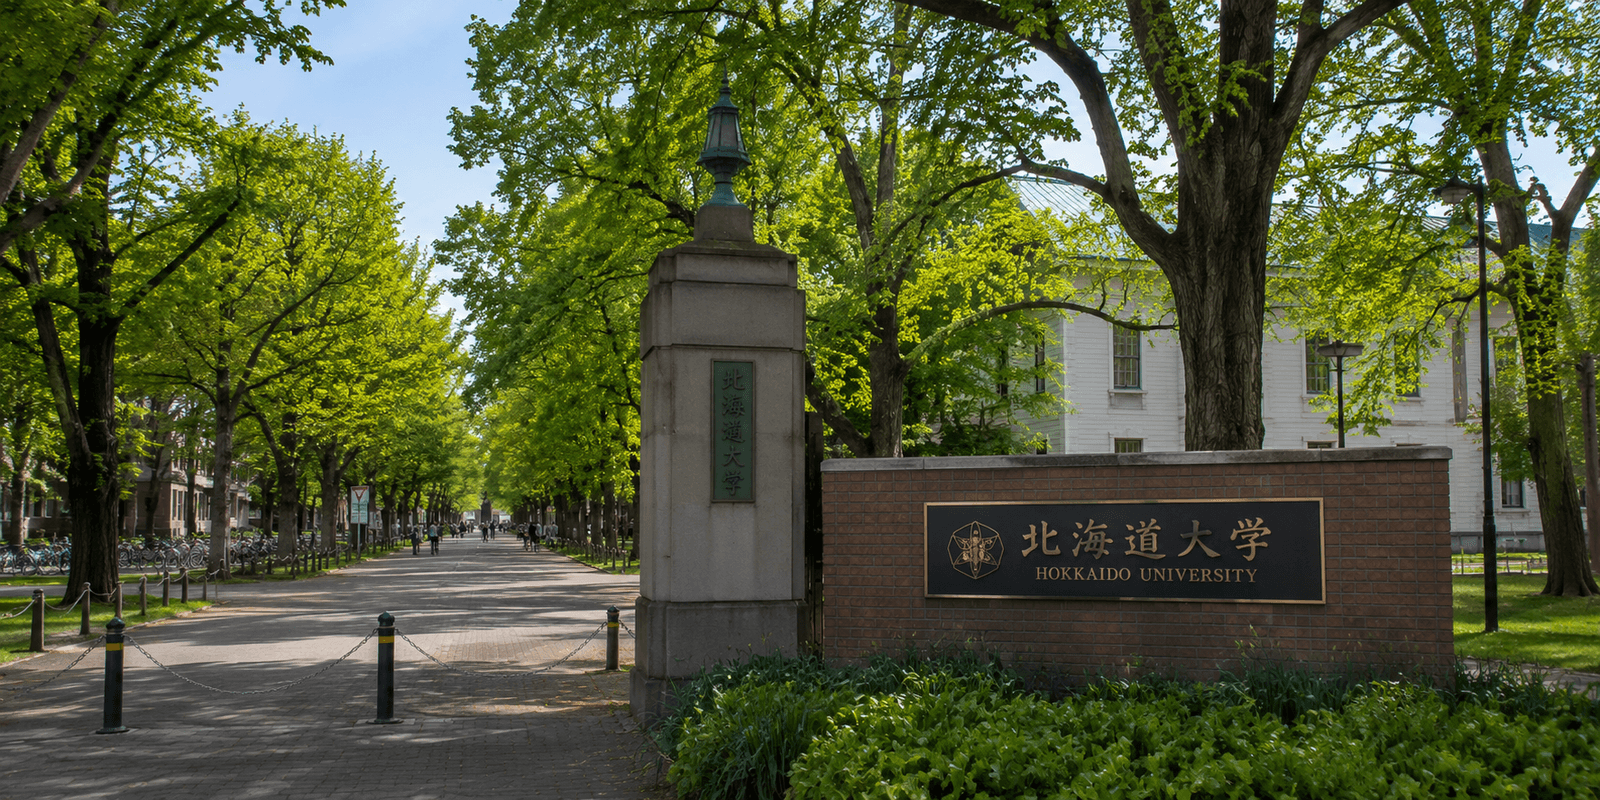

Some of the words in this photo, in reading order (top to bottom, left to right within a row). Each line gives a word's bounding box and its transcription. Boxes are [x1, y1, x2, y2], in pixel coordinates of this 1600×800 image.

[1021, 517, 1272, 562] 北海道大学
[1035, 566, 1131, 582] HOKKAIDO
[1140, 567, 1258, 583] UNIVERSITY
